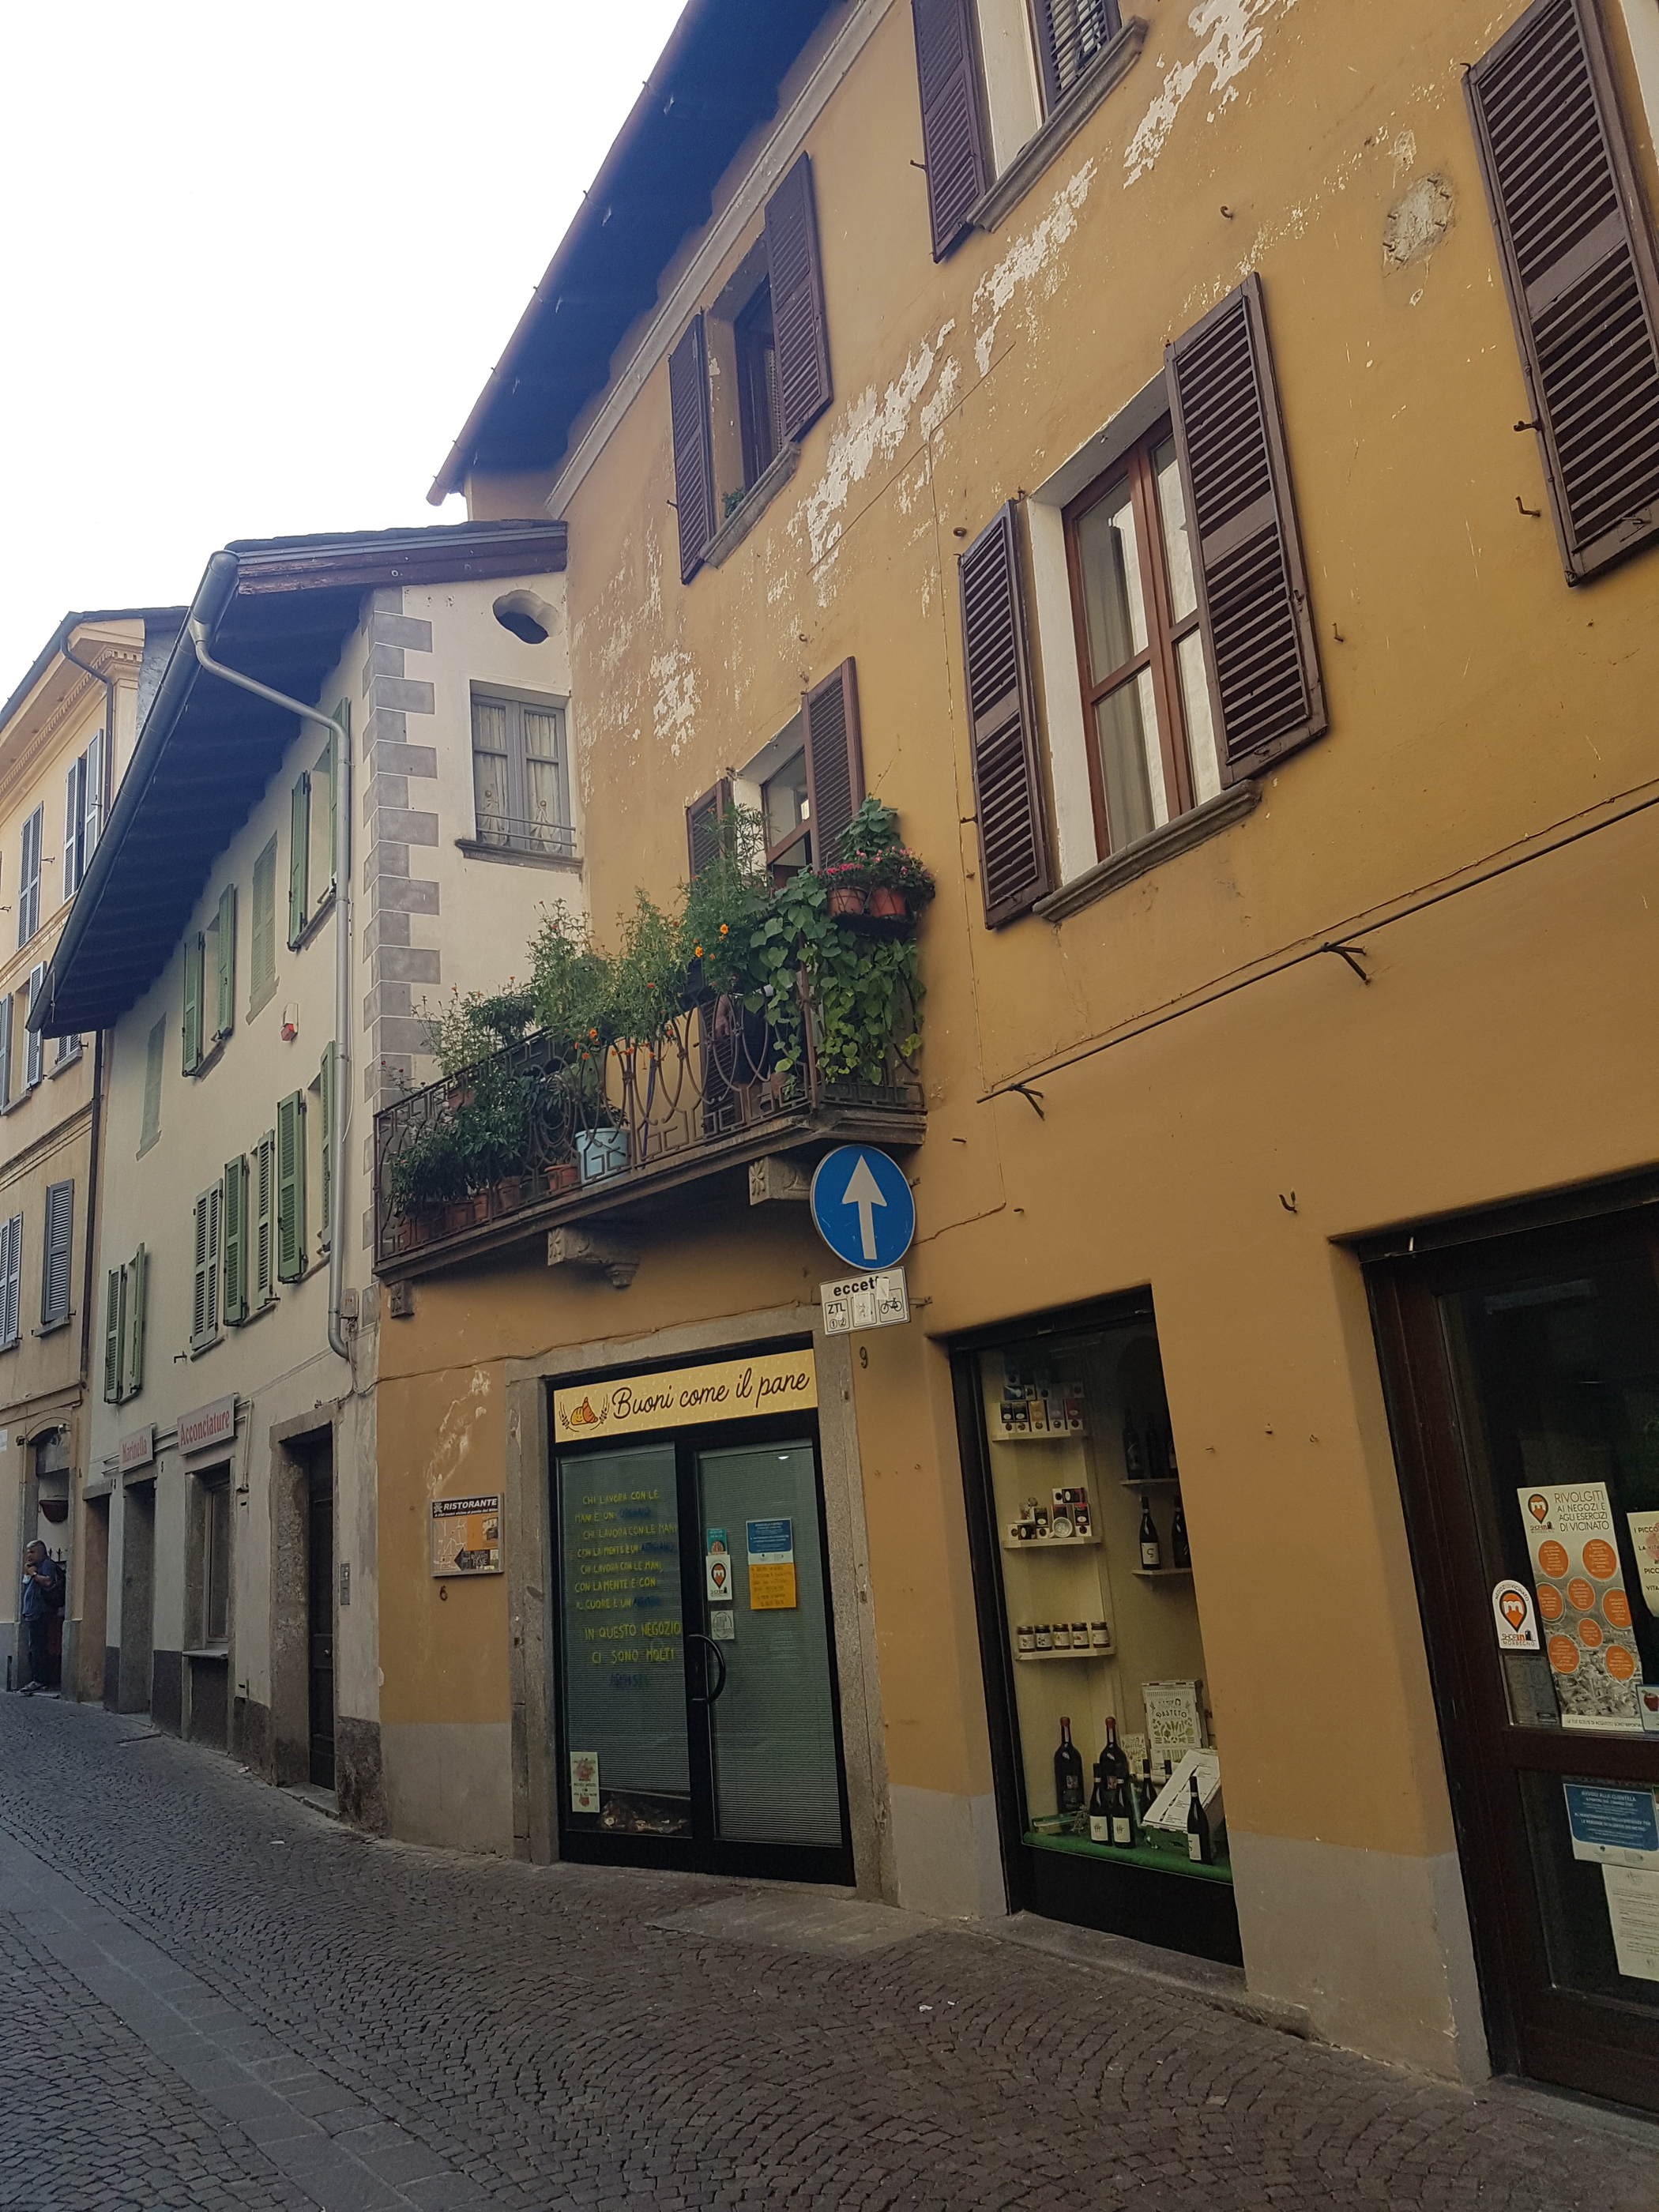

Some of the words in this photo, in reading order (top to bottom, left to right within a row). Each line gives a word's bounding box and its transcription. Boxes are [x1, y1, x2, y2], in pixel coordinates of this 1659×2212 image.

[833, 1276, 889, 1296] eccet
[828, 1303, 845, 1314] ZTL
[860, 1346, 868, 1368] 9
[611, 1385, 674, 1420] Buoni
[679, 1383, 729, 1408] come
[735, 1367, 752, 1398] il
[756, 1371, 810, 1409] pane
[180, 1410, 230, 1446] Acconciature
[122, 1435, 148, 1463] Marinella
[600, 1493, 627, 1504] LAVORA
[630, 1492, 645, 1500] CON
[649, 1489, 660, 1499] LE
[1554, 1490, 1604, 1503] RIVOLGITI
[443, 1499, 498, 1510] RISTORANTE
[1567, 1503, 1598, 1512] NEGOZI
[1576, 1512, 1608, 1521] ESERCIZI
[583, 1530, 595, 1540] CHI
[599, 1528, 626, 1538] LAVORA
[628, 1525, 644, 1536] CON
[645, 1524, 655, 1533] LE
[1560, 1522, 1568, 1532] DI
[1570, 1521, 1609, 1531] VICINATO
[593, 1563, 619, 1573] LAVORA
[619, 1562, 632, 1571] CON
[634, 1561, 643, 1571] LE
[575, 1582, 590, 1593] CON
[593, 1582, 602, 1591] LA
[604, 1581, 628, 1591] MENTE
[639, 1577, 656, 1587] CON
[585, 1597, 611, 1609] CUORE
[585, 1627, 594, 1640] IN
[600, 1623, 637, 1640] QUESTO
[641, 1621, 681, 1637] NEGOZIO
[592, 1652, 601, 1665] CI
[611, 1649, 638, 1665] SONO
[646, 1646, 674, 1661] MOLTI
